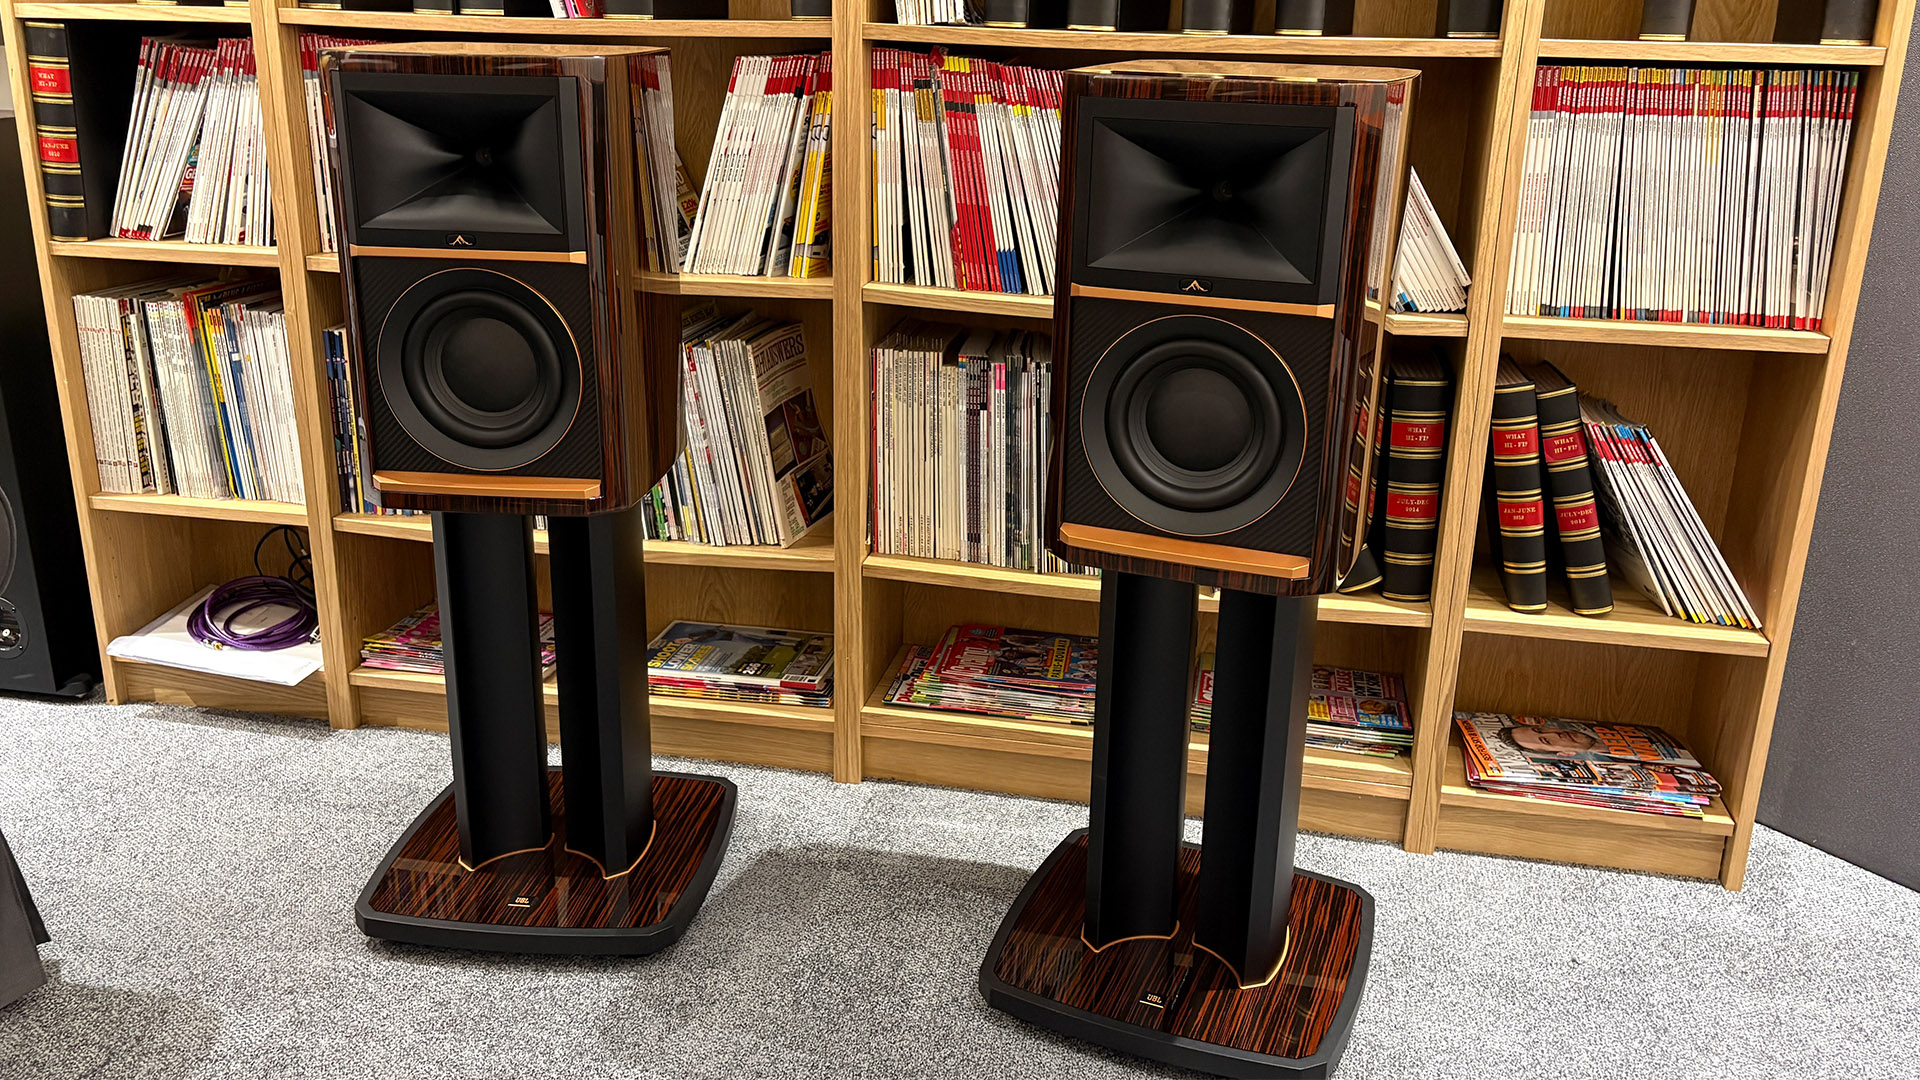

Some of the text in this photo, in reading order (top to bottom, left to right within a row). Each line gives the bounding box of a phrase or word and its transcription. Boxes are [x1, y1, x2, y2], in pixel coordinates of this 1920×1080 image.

[1554, 437, 1574, 445] WHAT
[648, 641, 677, 668] SHOOT
[663, 643, 697, 669] LOWER
[1593, 726, 1636, 756] DEEP
[1613, 726, 1662, 761] WATER
